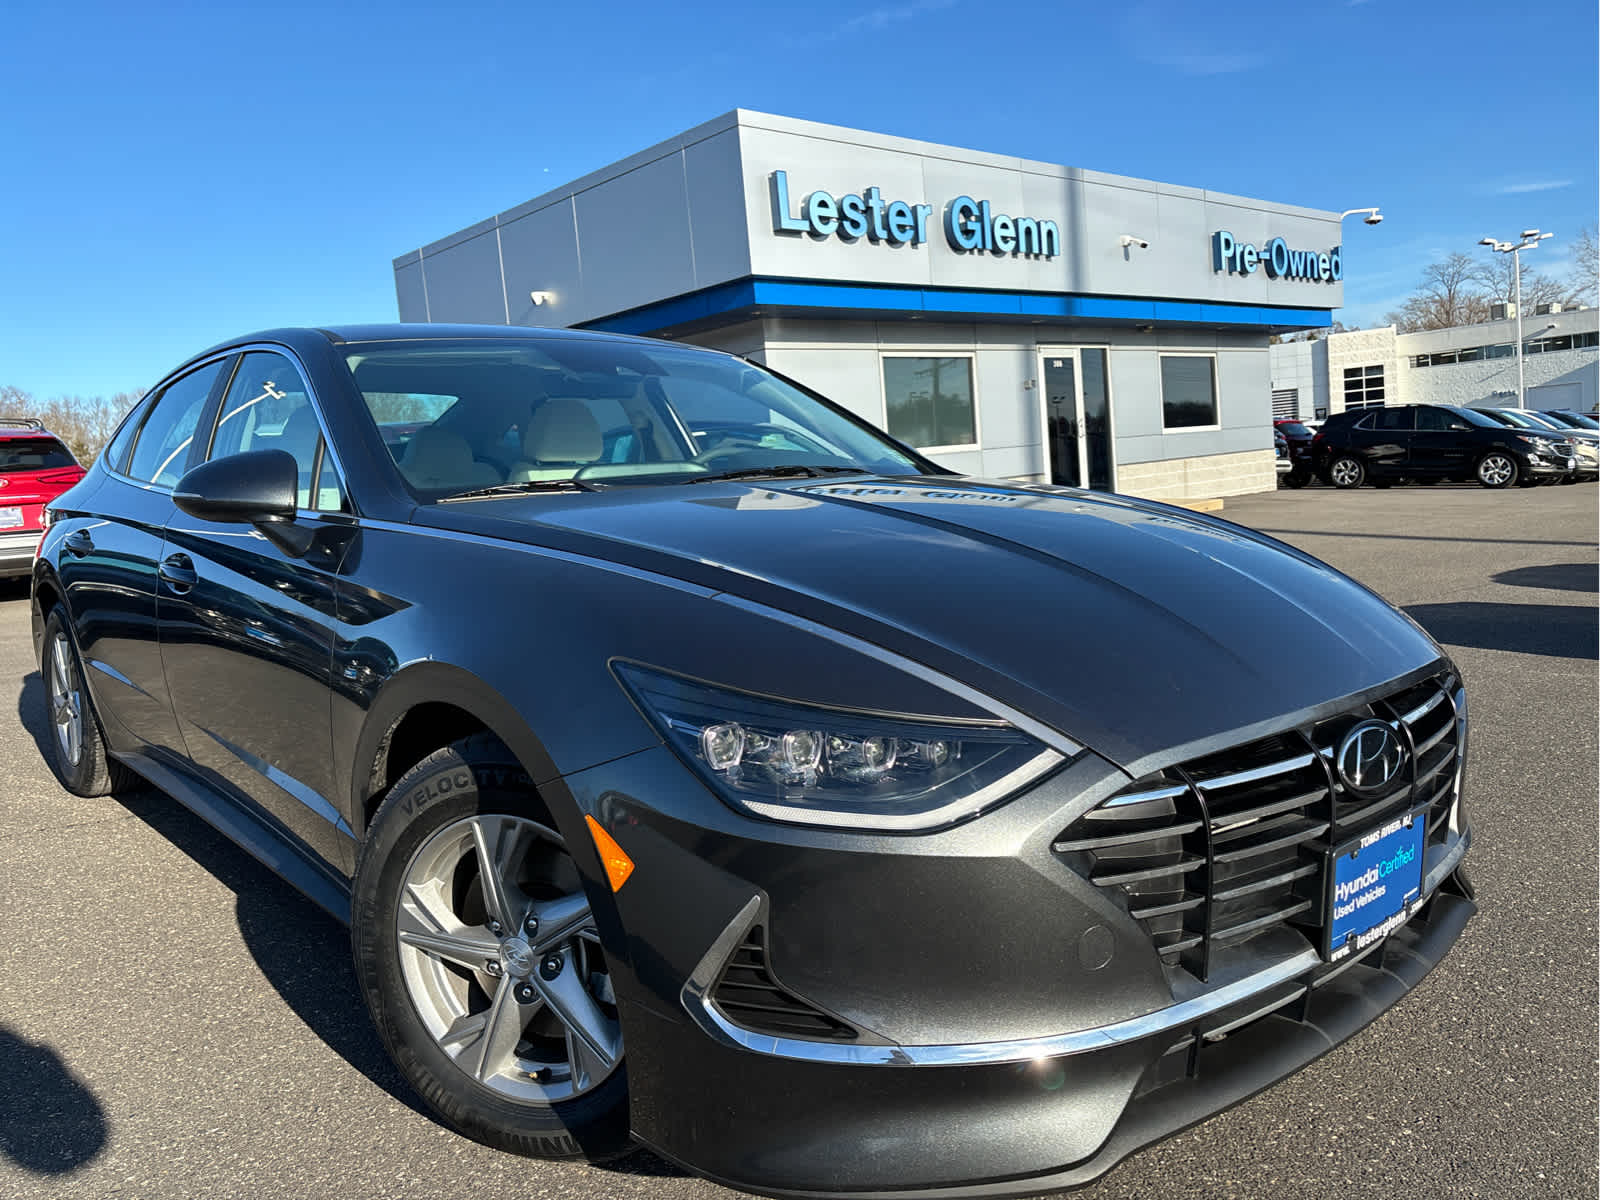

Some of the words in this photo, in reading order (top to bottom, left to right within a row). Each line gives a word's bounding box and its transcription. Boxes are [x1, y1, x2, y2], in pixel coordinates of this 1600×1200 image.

[769, 170, 931, 246] Lester
[943, 196, 1061, 258] Glenn
[1212, 231, 1344, 283] Pre-Owned
[1360, 830, 1380, 849] TOMS
[1333, 898, 1355, 920] Used
[1356, 885, 1386, 909] Vehicles
[1356, 911, 1406, 949] lesterglenn
